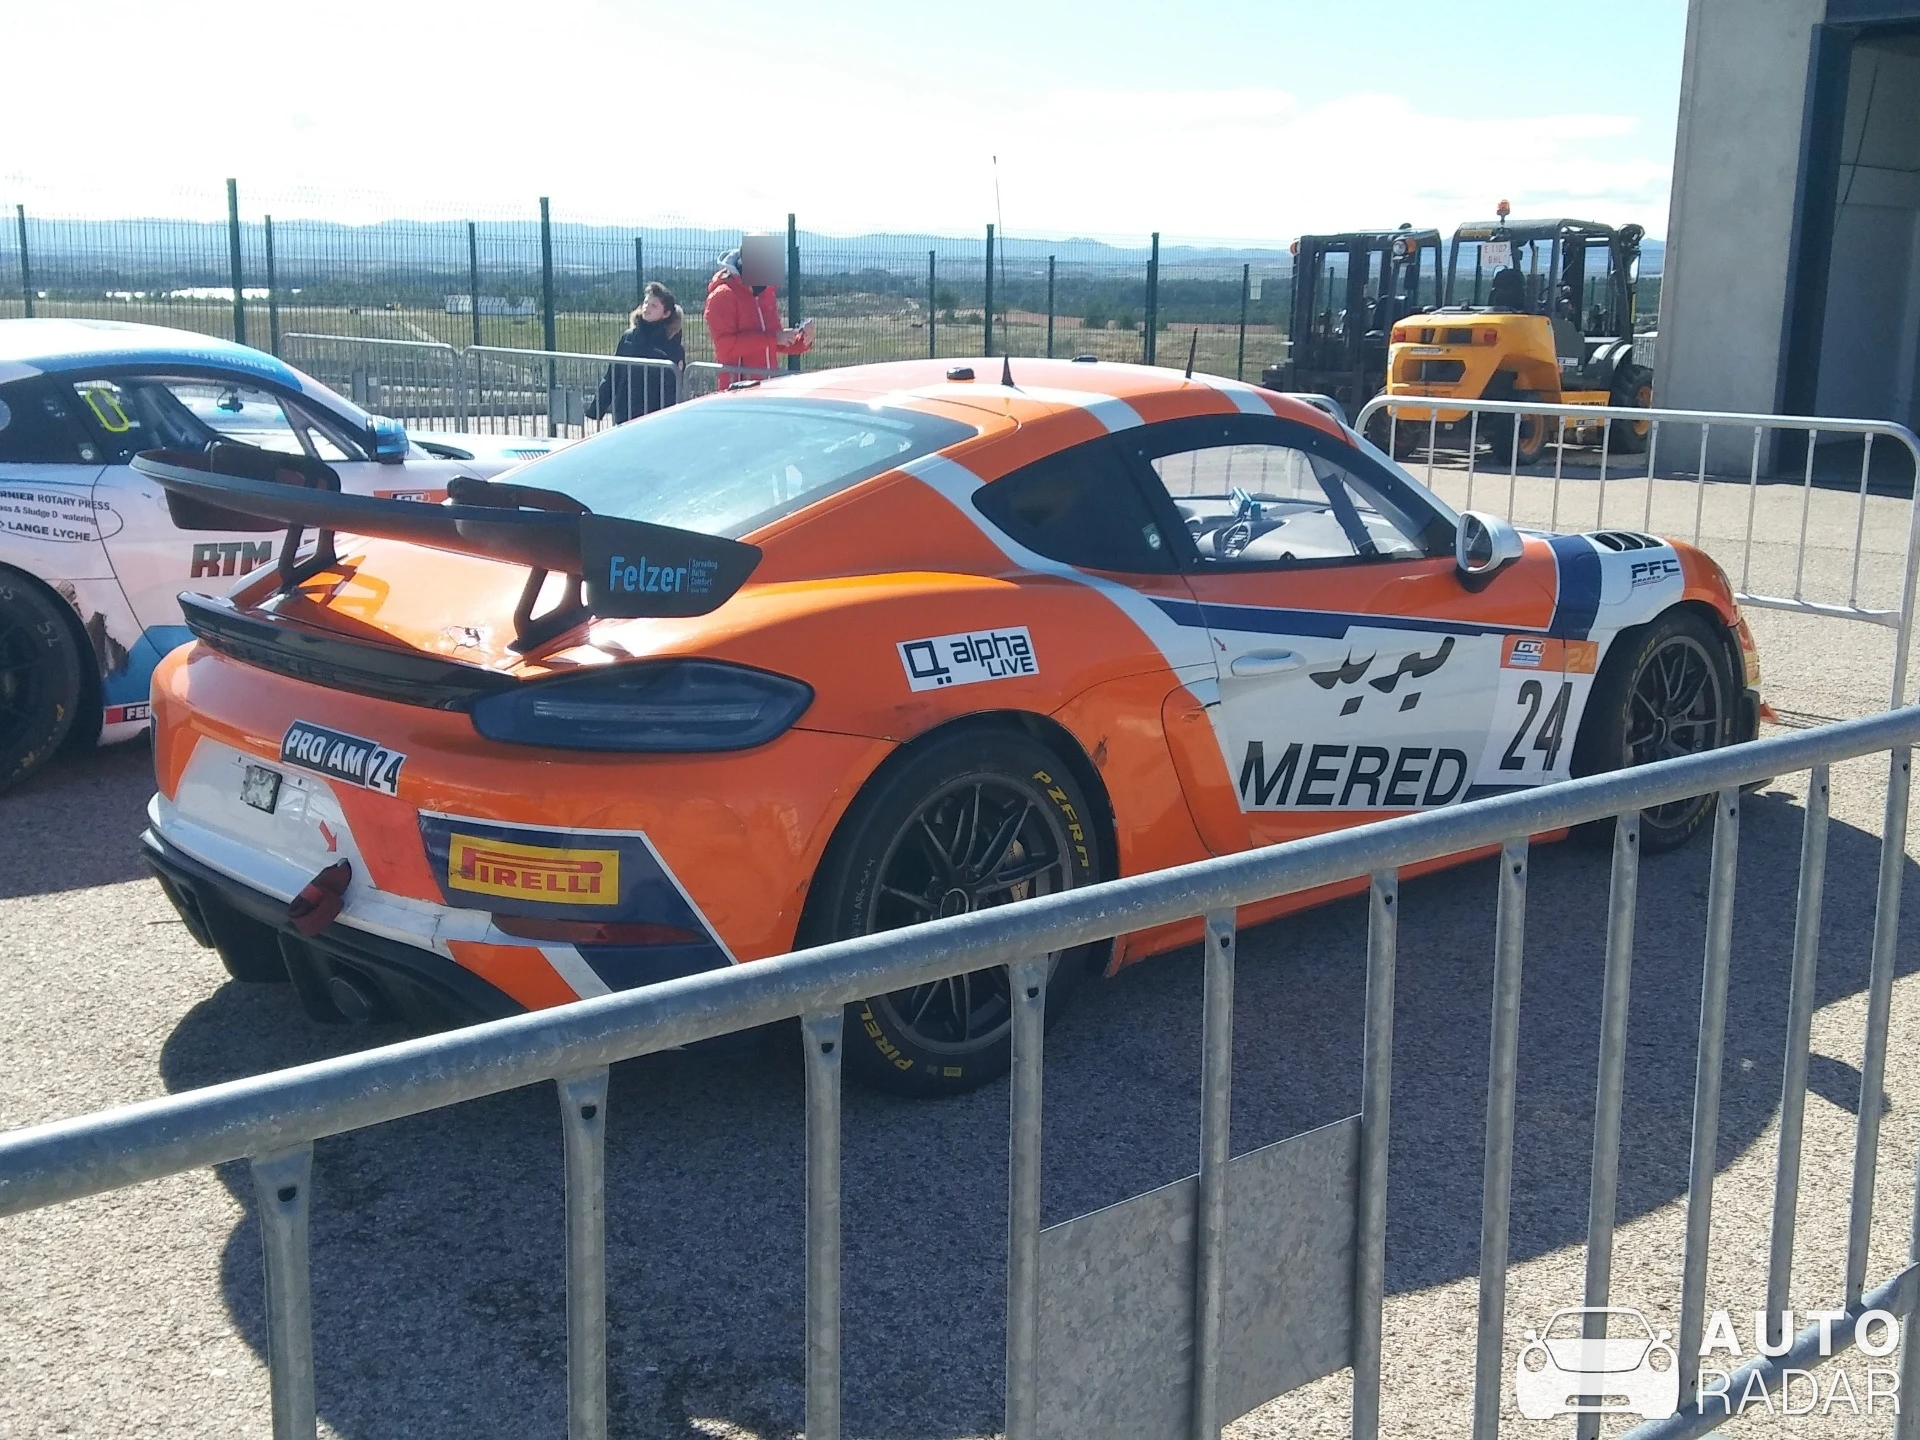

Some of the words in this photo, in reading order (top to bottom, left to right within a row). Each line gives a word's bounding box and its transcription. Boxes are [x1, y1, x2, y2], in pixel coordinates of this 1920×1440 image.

[23, 507, 50, 519] Sludge
[38, 494, 75, 507] ROTARY
[78, 499, 110, 511] PRESS
[8, 521, 49, 535] LANGE
[53, 528, 91, 541] LYCHE
[190, 540, 272, 578] RTM
[609, 555, 687, 592] Felzer
[1631, 559, 1680, 579] PFC
[950, 632, 1030, 667] alpha
[1514, 639, 1547, 654] GT4
[1565, 643, 1596, 673] 24
[987, 655, 1035, 677] LIVE
[1499, 679, 1573, 771] 24
[285, 728, 368, 777] PRO/AM
[369, 750, 404, 793] 24
[1239, 741, 1468, 806] MERED
[460, 846, 604, 894] PIRELLI
